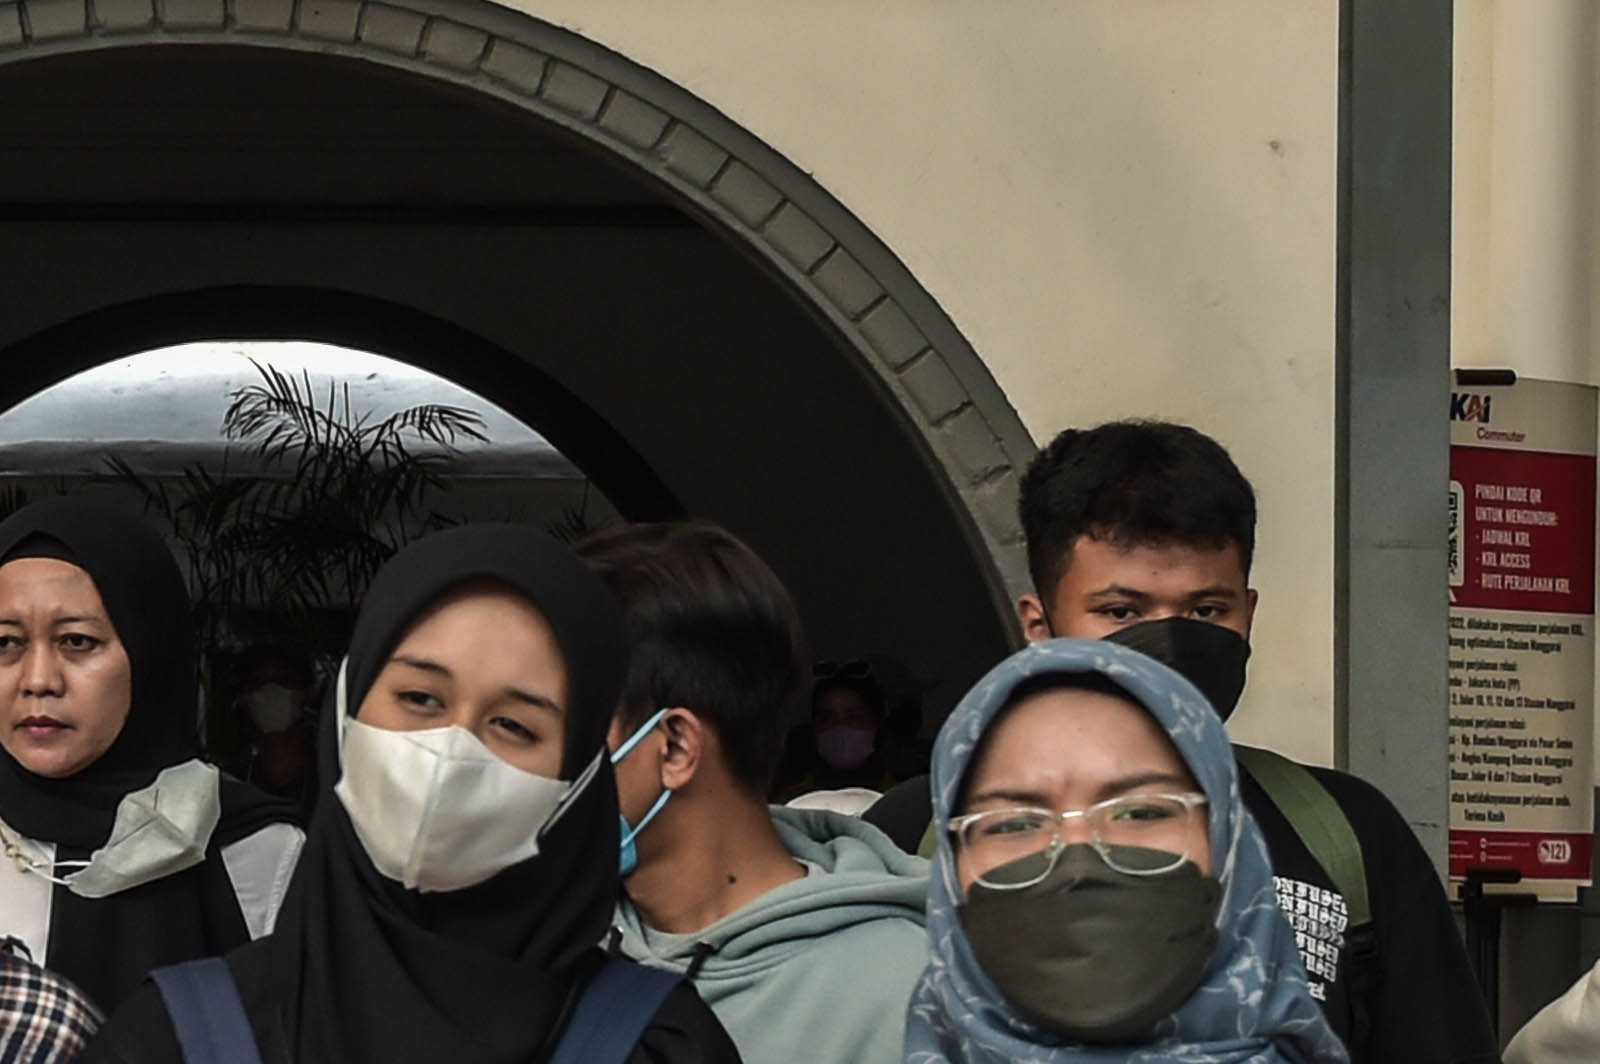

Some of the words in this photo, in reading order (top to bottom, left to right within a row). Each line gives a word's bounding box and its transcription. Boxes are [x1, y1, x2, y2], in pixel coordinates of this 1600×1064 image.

[1477, 427, 1527, 443] Commuter
[1475, 483, 1504, 502] PINDAI
[1506, 486, 1528, 503] KODE
[1529, 488, 1542, 505] QR
[1475, 505, 1503, 523] UNTUK
[1482, 528, 1513, 546] JADWAL
[1515, 531, 1531, 547] KRL
[1481, 551, 1498, 567] KRL
[1499, 552, 1531, 569] ACCESS
[1481, 572, 1503, 590] RUTE
[1504, 573, 1554, 592] PERJALANAN
[1555, 577, 1571, 594] KRL
[1550, 843, 1566, 861] 121
